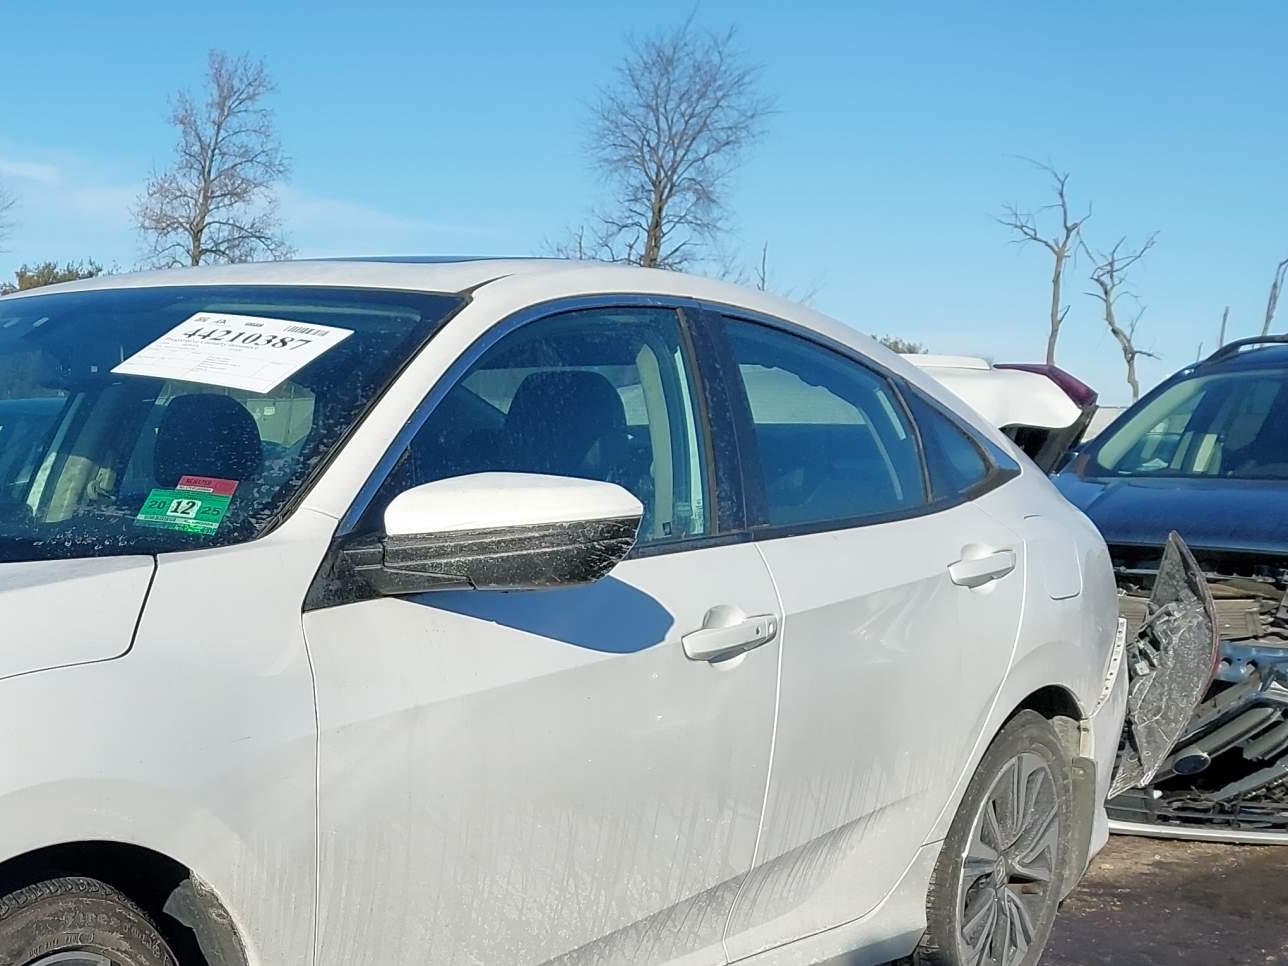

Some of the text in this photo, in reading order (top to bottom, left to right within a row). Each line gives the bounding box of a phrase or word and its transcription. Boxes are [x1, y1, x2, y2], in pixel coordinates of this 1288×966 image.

[183, 327, 312, 351] 44210387
[147, 500, 221, 516] 20 12 25
